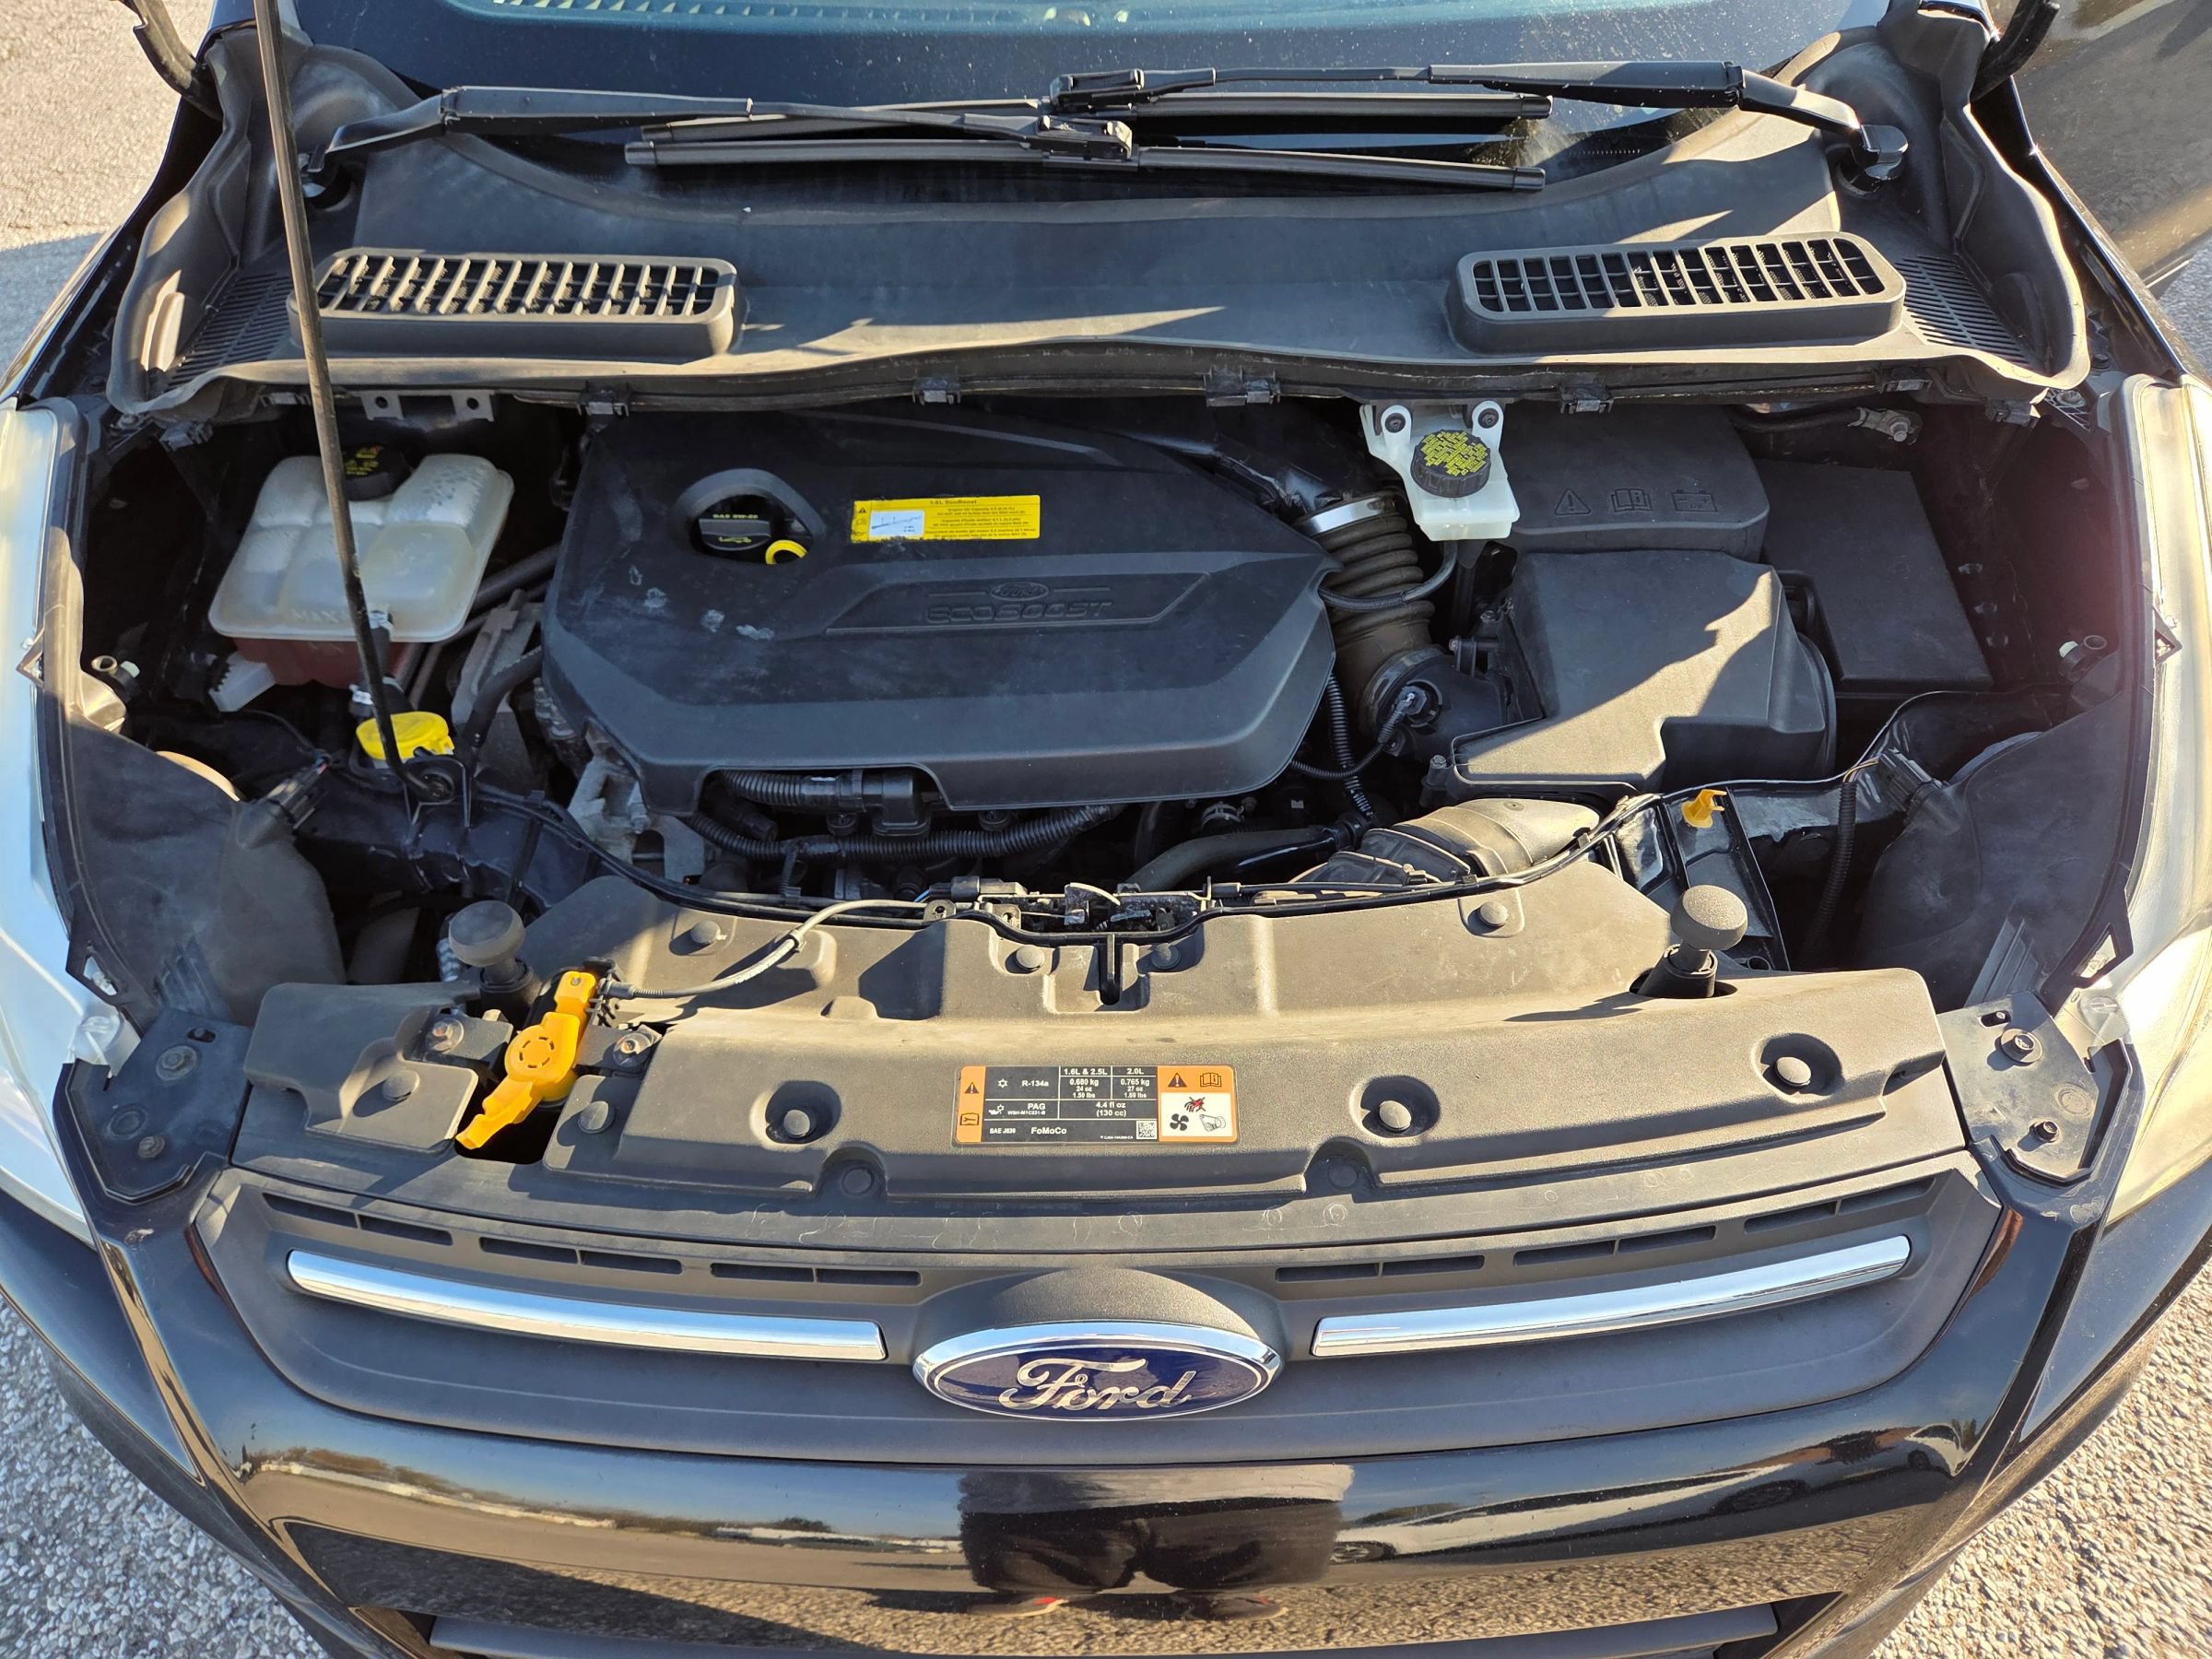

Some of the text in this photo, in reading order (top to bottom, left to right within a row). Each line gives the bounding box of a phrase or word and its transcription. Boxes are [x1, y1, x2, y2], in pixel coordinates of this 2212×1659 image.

[1090, 1067, 1108, 1076] 2.5L
[1022, 1079, 1050, 1088] R-134a
[1090, 1078, 1100, 1087] kg
[1141, 1078, 1151, 1087] kg
[1096, 1110, 1127, 1118] (130 cc)
[1031, 1127, 1067, 1135] FoMoCo
[998, 1358, 1197, 1410] Ford
